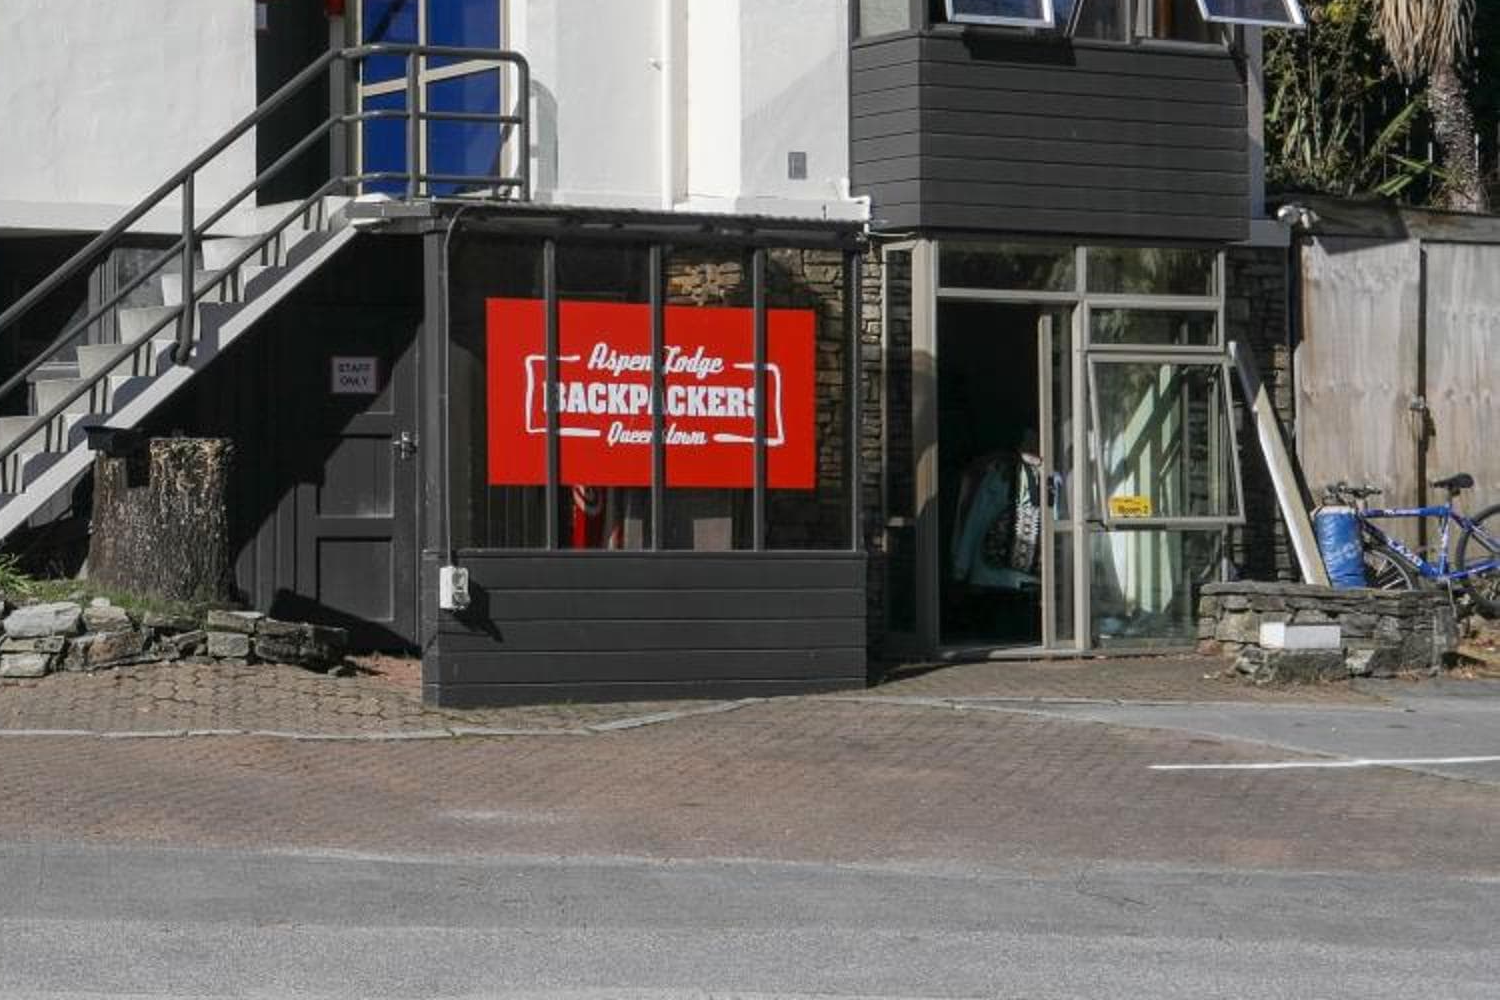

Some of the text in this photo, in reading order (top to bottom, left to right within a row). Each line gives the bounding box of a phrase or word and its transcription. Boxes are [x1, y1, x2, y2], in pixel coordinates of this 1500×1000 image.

[339, 363, 373, 374] STAFF
[587, 342, 724, 379] Aspen Lodge
[340, 375, 369, 387] ONLY
[543, 381, 758, 418] BACKPCKERS
[607, 420, 708, 447] Queentown
